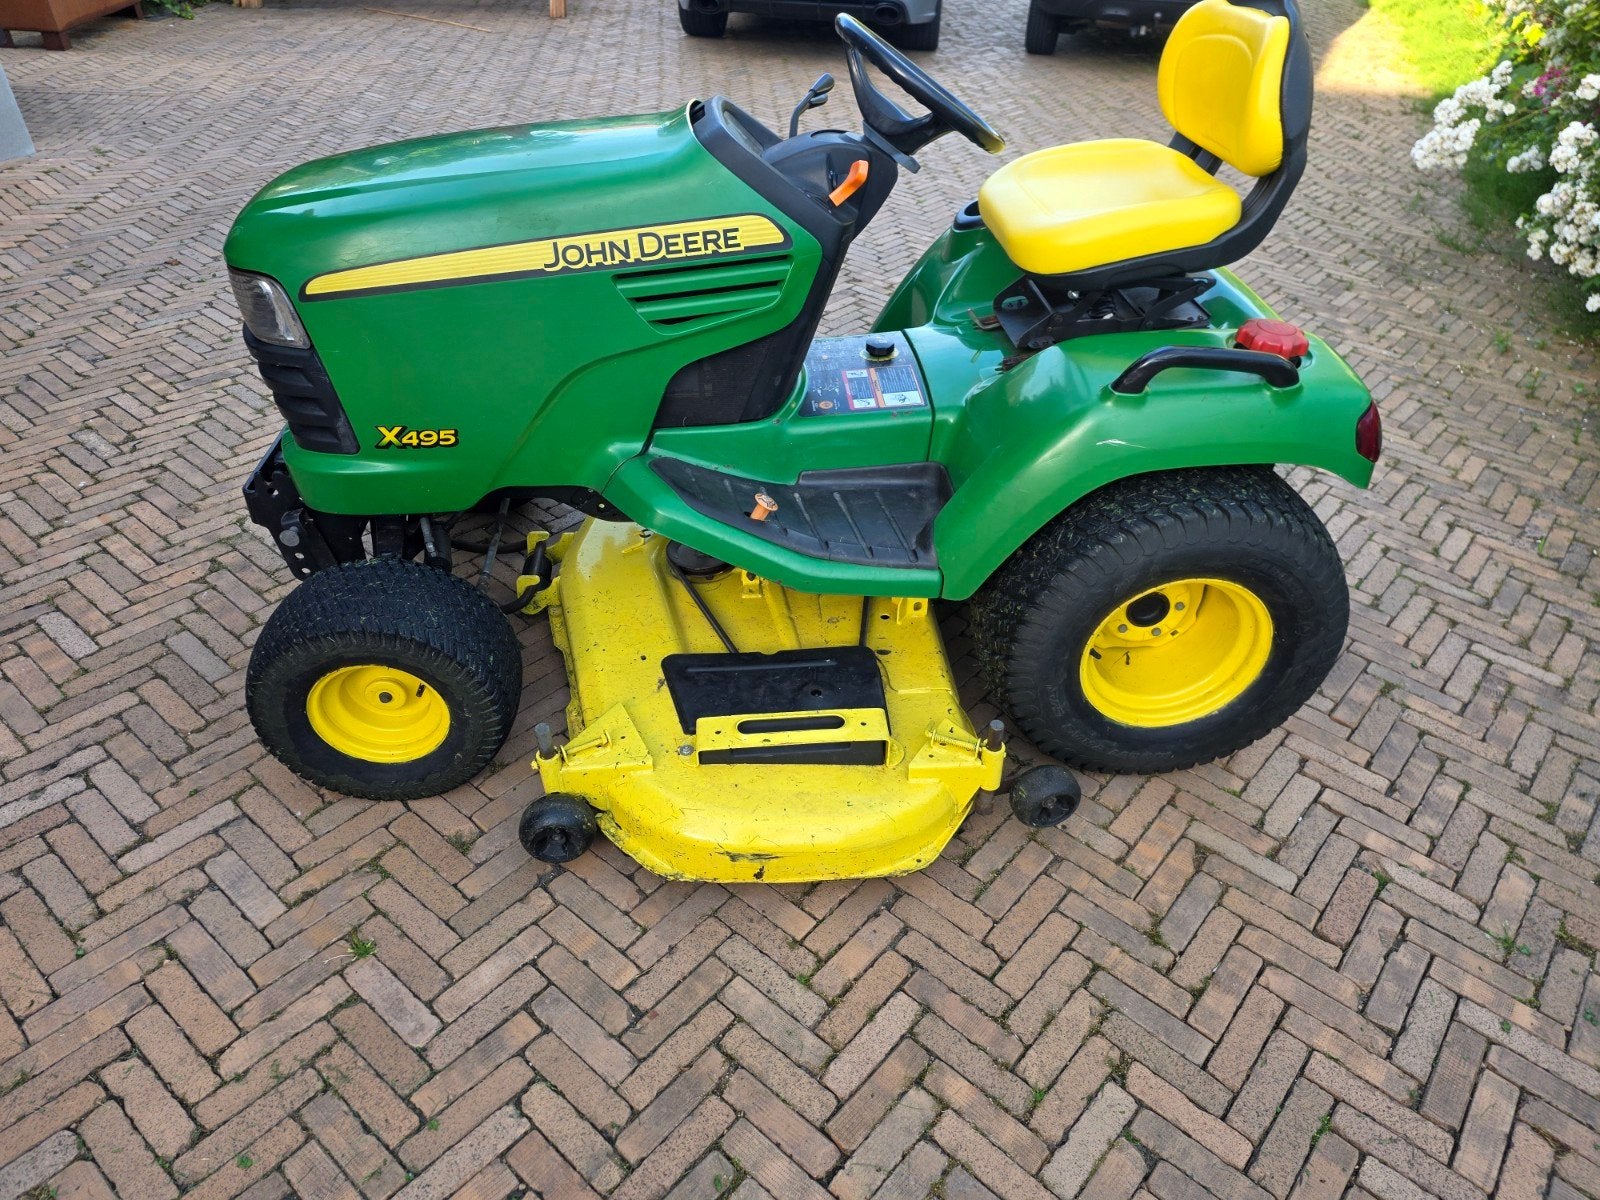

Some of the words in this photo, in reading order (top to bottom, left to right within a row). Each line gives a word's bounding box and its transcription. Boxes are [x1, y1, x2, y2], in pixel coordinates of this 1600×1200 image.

[543, 238, 631, 269] JOHN
[637, 227, 742, 258] DEERE
[376, 425, 457, 447] X495
